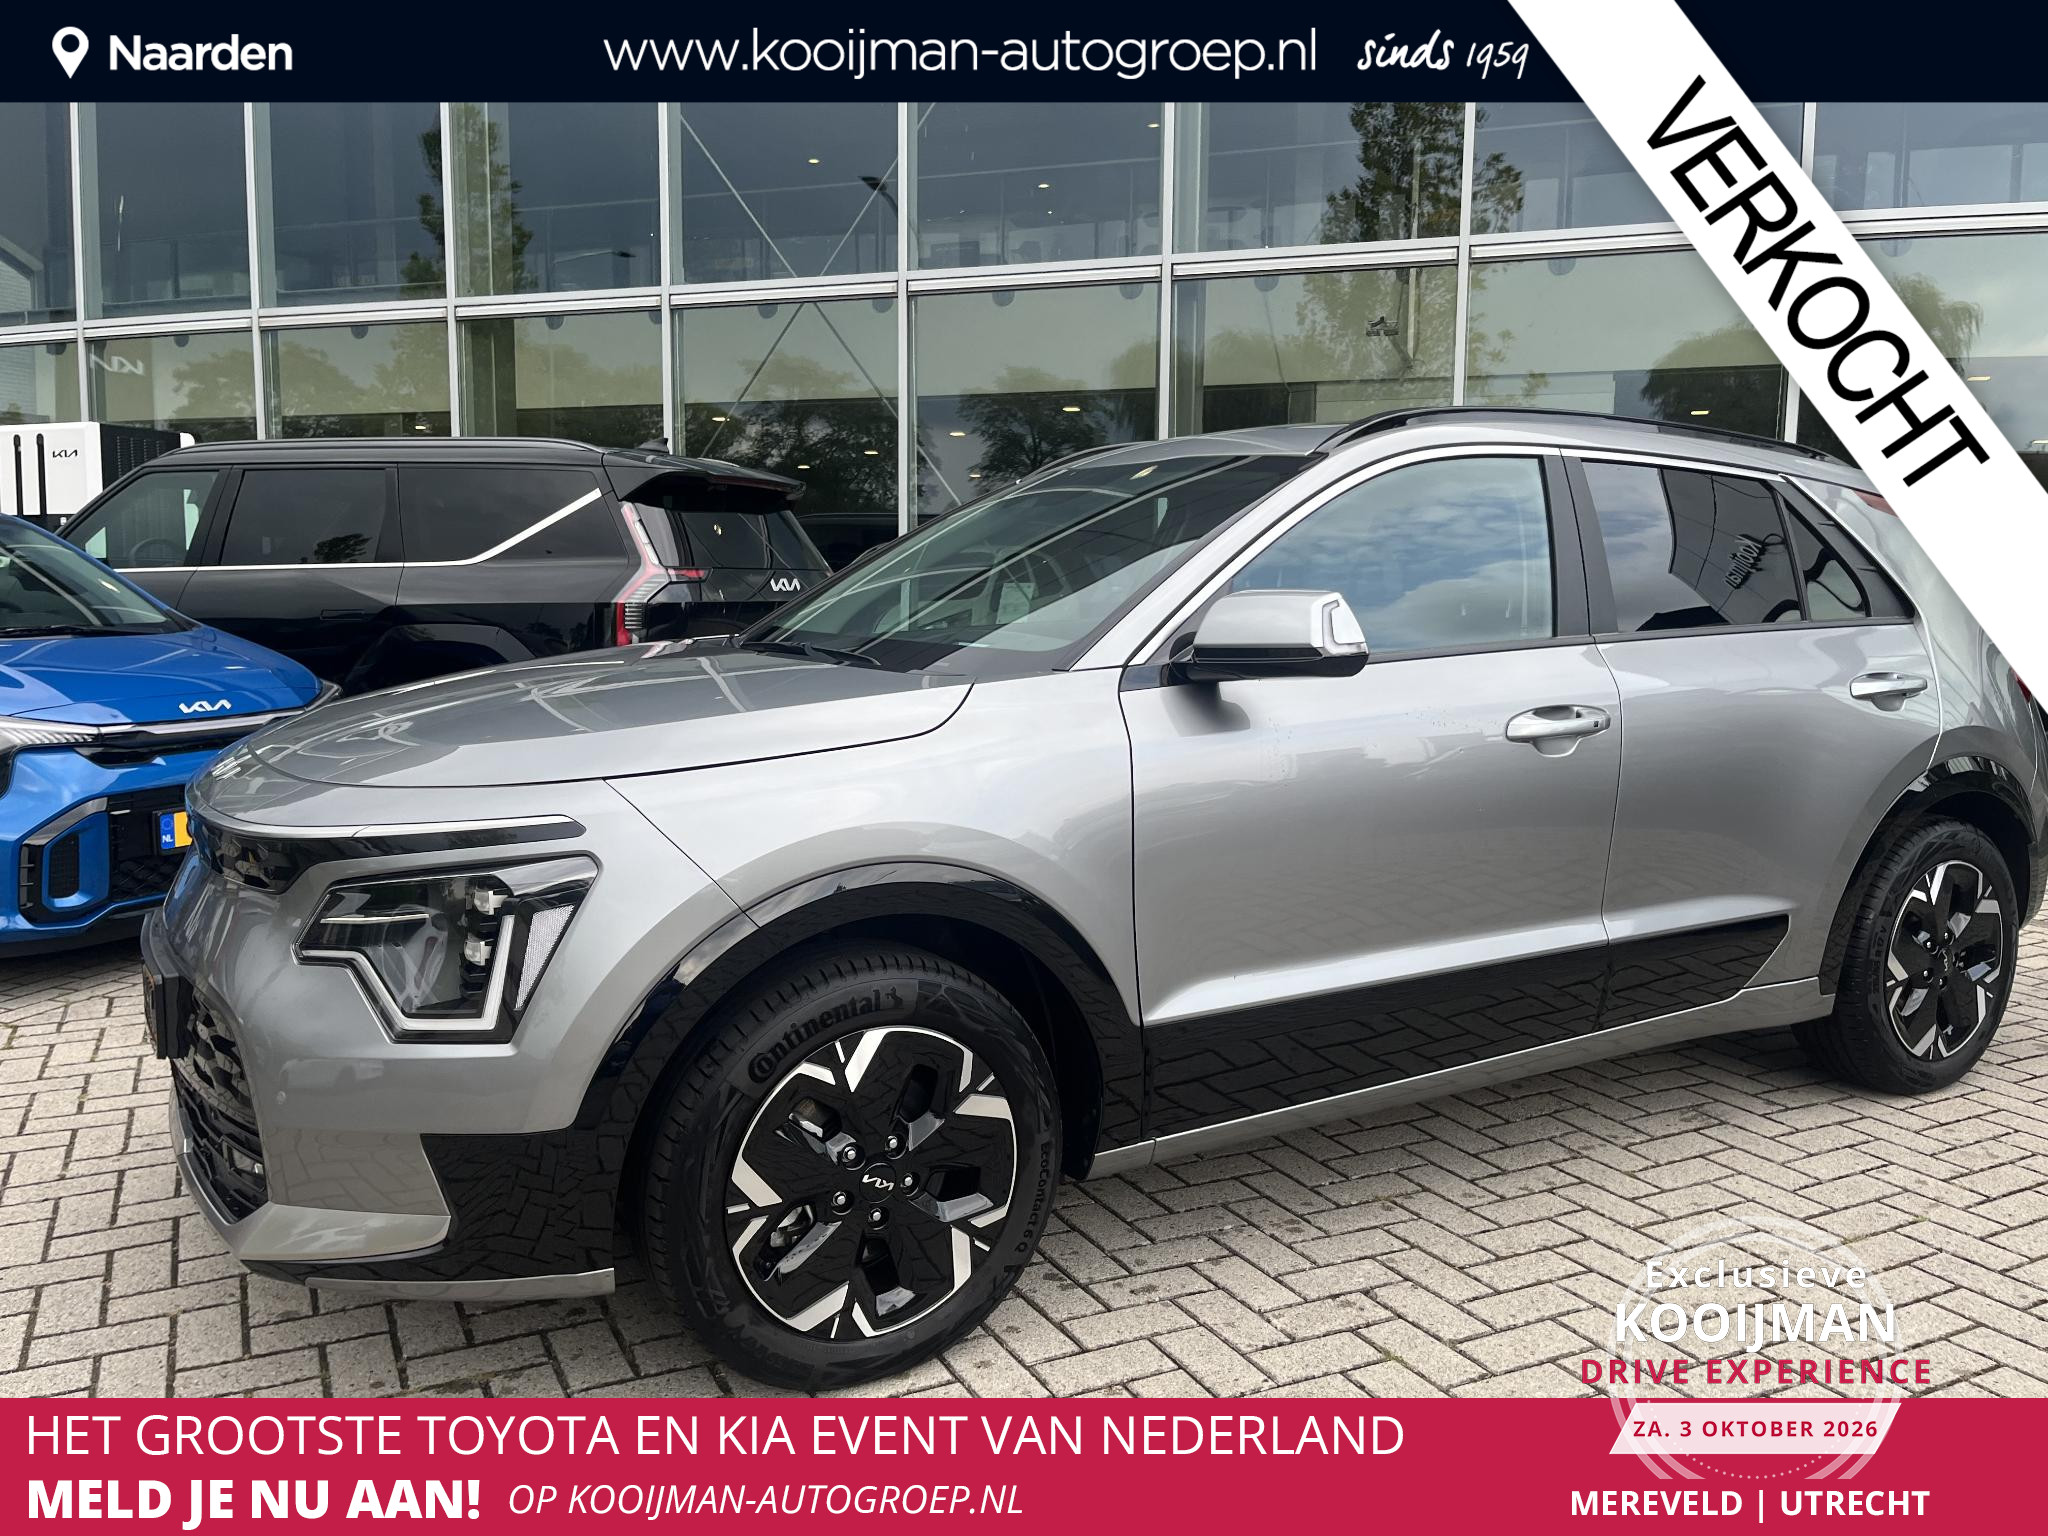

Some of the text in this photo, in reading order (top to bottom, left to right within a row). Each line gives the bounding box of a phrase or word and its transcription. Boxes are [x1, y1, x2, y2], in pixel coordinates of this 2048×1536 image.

[770, 577, 801, 592] KIA
[179, 699, 232, 714] KIA
[162, 834, 174, 844] NL
[748, 988, 881, 1084] Continental
